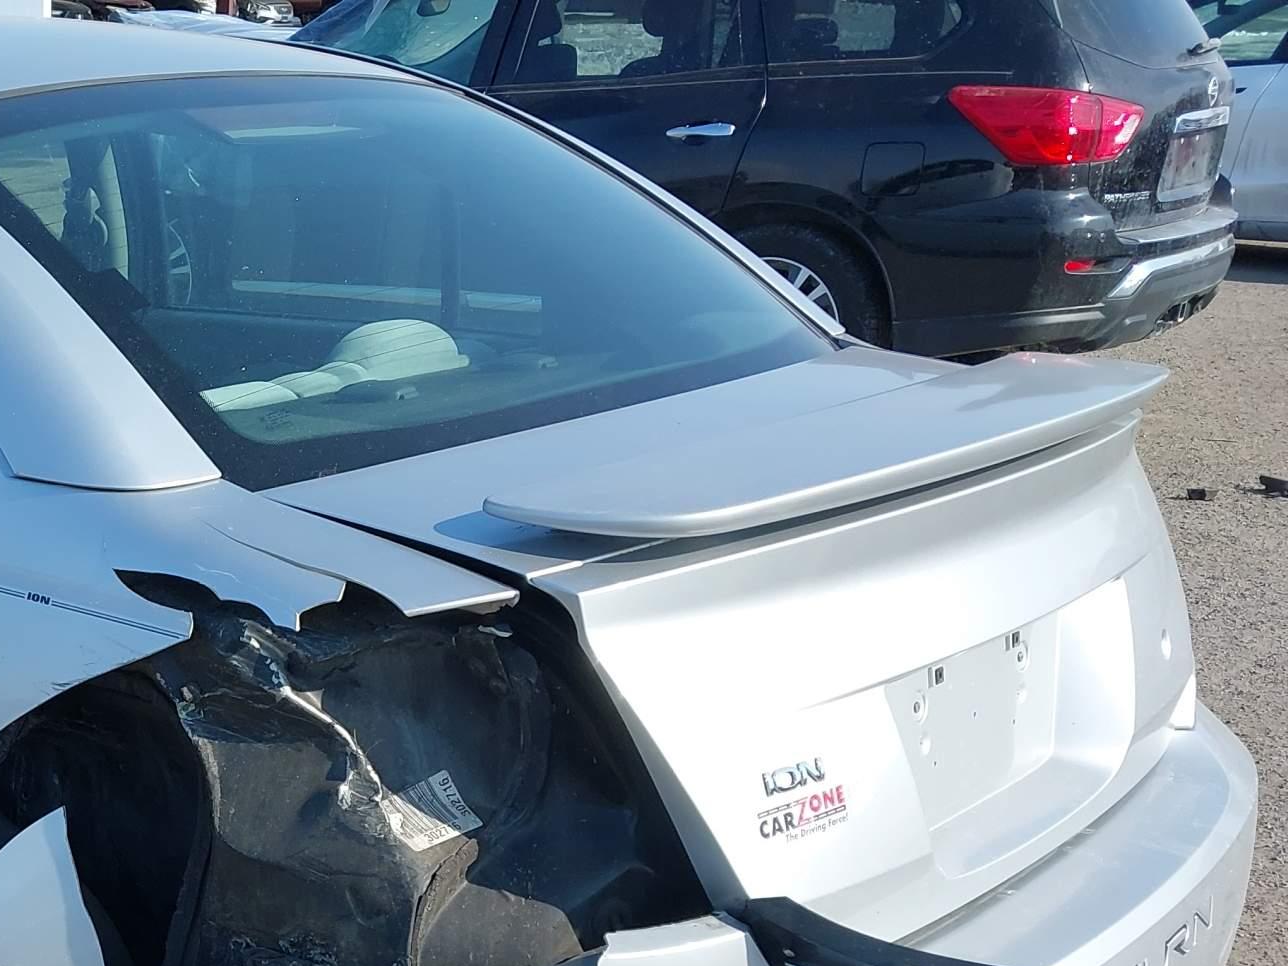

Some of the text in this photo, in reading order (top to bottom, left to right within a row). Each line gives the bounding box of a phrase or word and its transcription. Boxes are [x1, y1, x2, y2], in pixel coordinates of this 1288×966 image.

[26, 591, 51, 605] ION
[438, 775, 472, 817] 302716
[762, 757, 825, 797] ION
[759, 784, 846, 839] CARZONE
[785, 833, 799, 843] The
[800, 822, 827, 838] Driving
